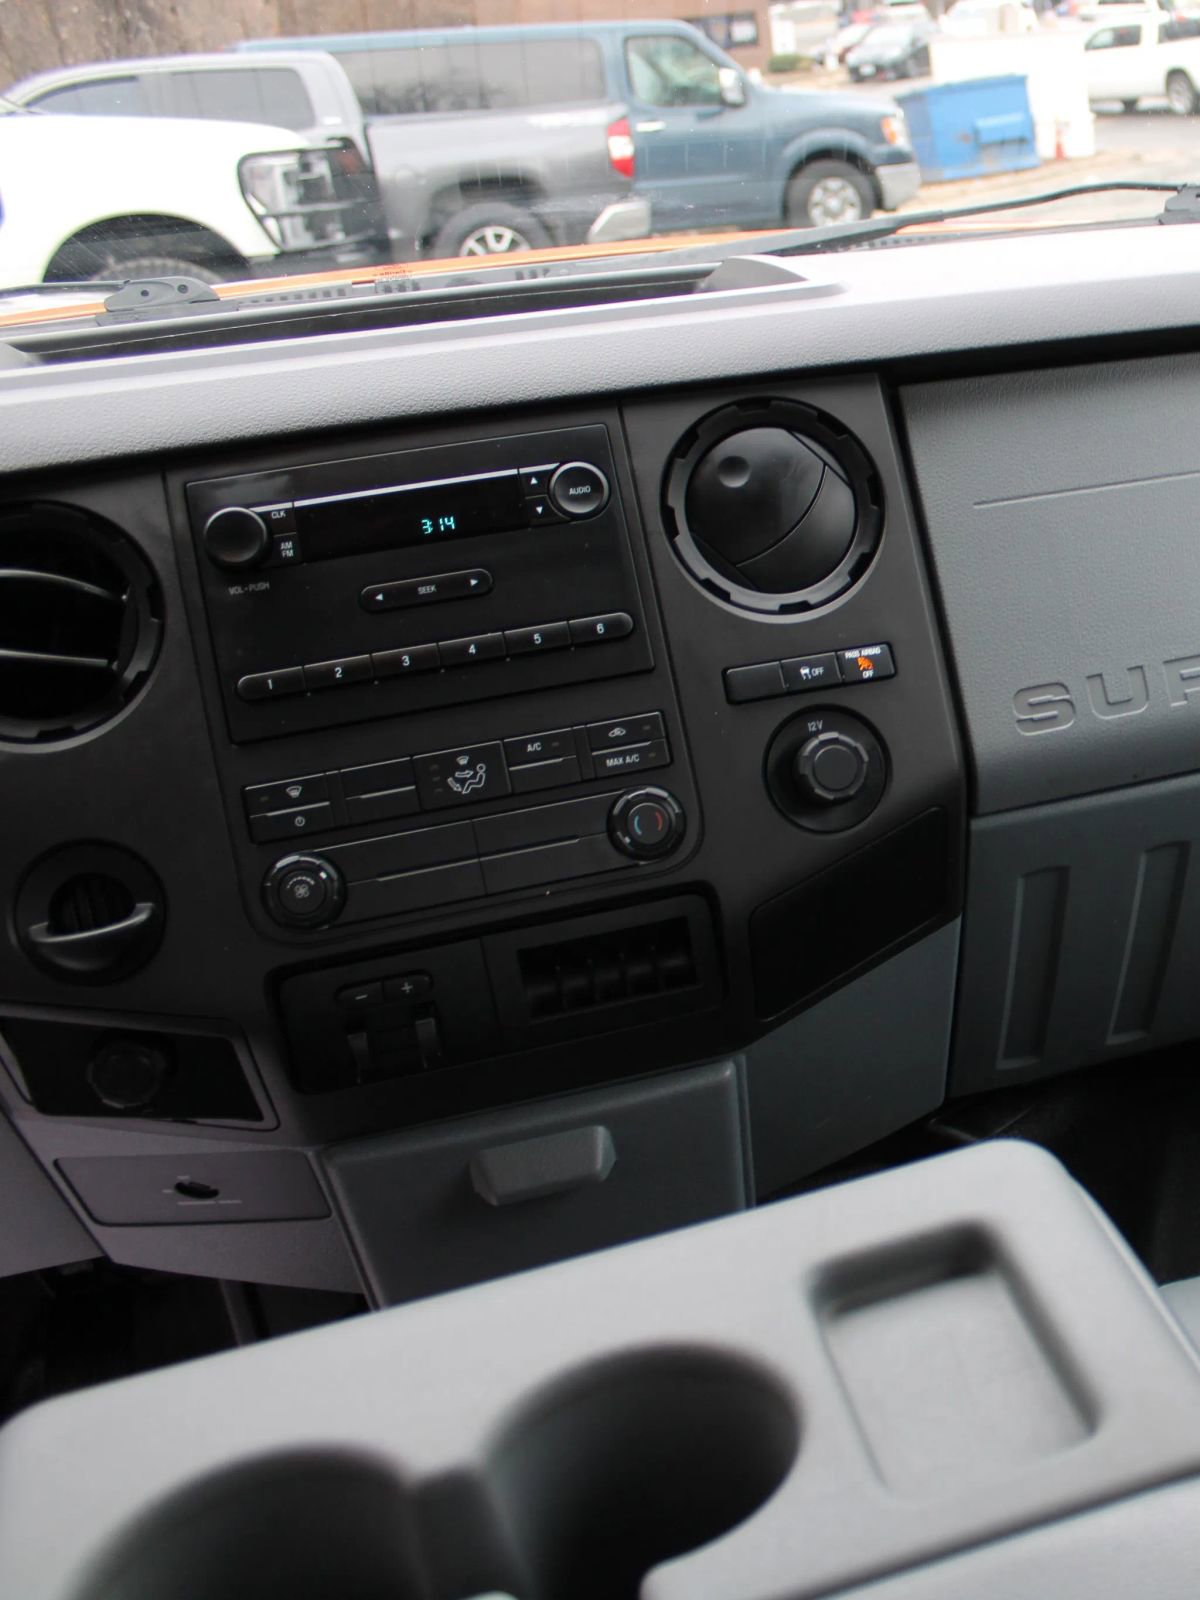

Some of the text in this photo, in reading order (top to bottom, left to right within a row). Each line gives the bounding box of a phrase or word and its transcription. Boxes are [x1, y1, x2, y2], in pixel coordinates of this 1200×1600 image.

[568, 485, 591, 496] AUDIO
[271, 511, 286, 519] CLK
[421, 516, 456, 534] 3:14
[280, 541, 293, 550] AM
[282, 549, 294, 558] FM
[228, 582, 270, 595] VOL PUSH
[417, 584, 437, 594] SEEK
[596, 623, 605, 634] 6
[533, 633, 542, 644] 5
[468, 644, 477, 655] 4
[402, 655, 411, 666] 3
[334, 667, 343, 678] 2
[811, 667, 824, 676] OFF
[862, 670, 874, 679] OFF
[267, 679, 273, 690] 1
[807, 720, 823, 732] 12V
[527, 742, 542, 753] A/C
[606, 754, 640, 767] MAX A/C
